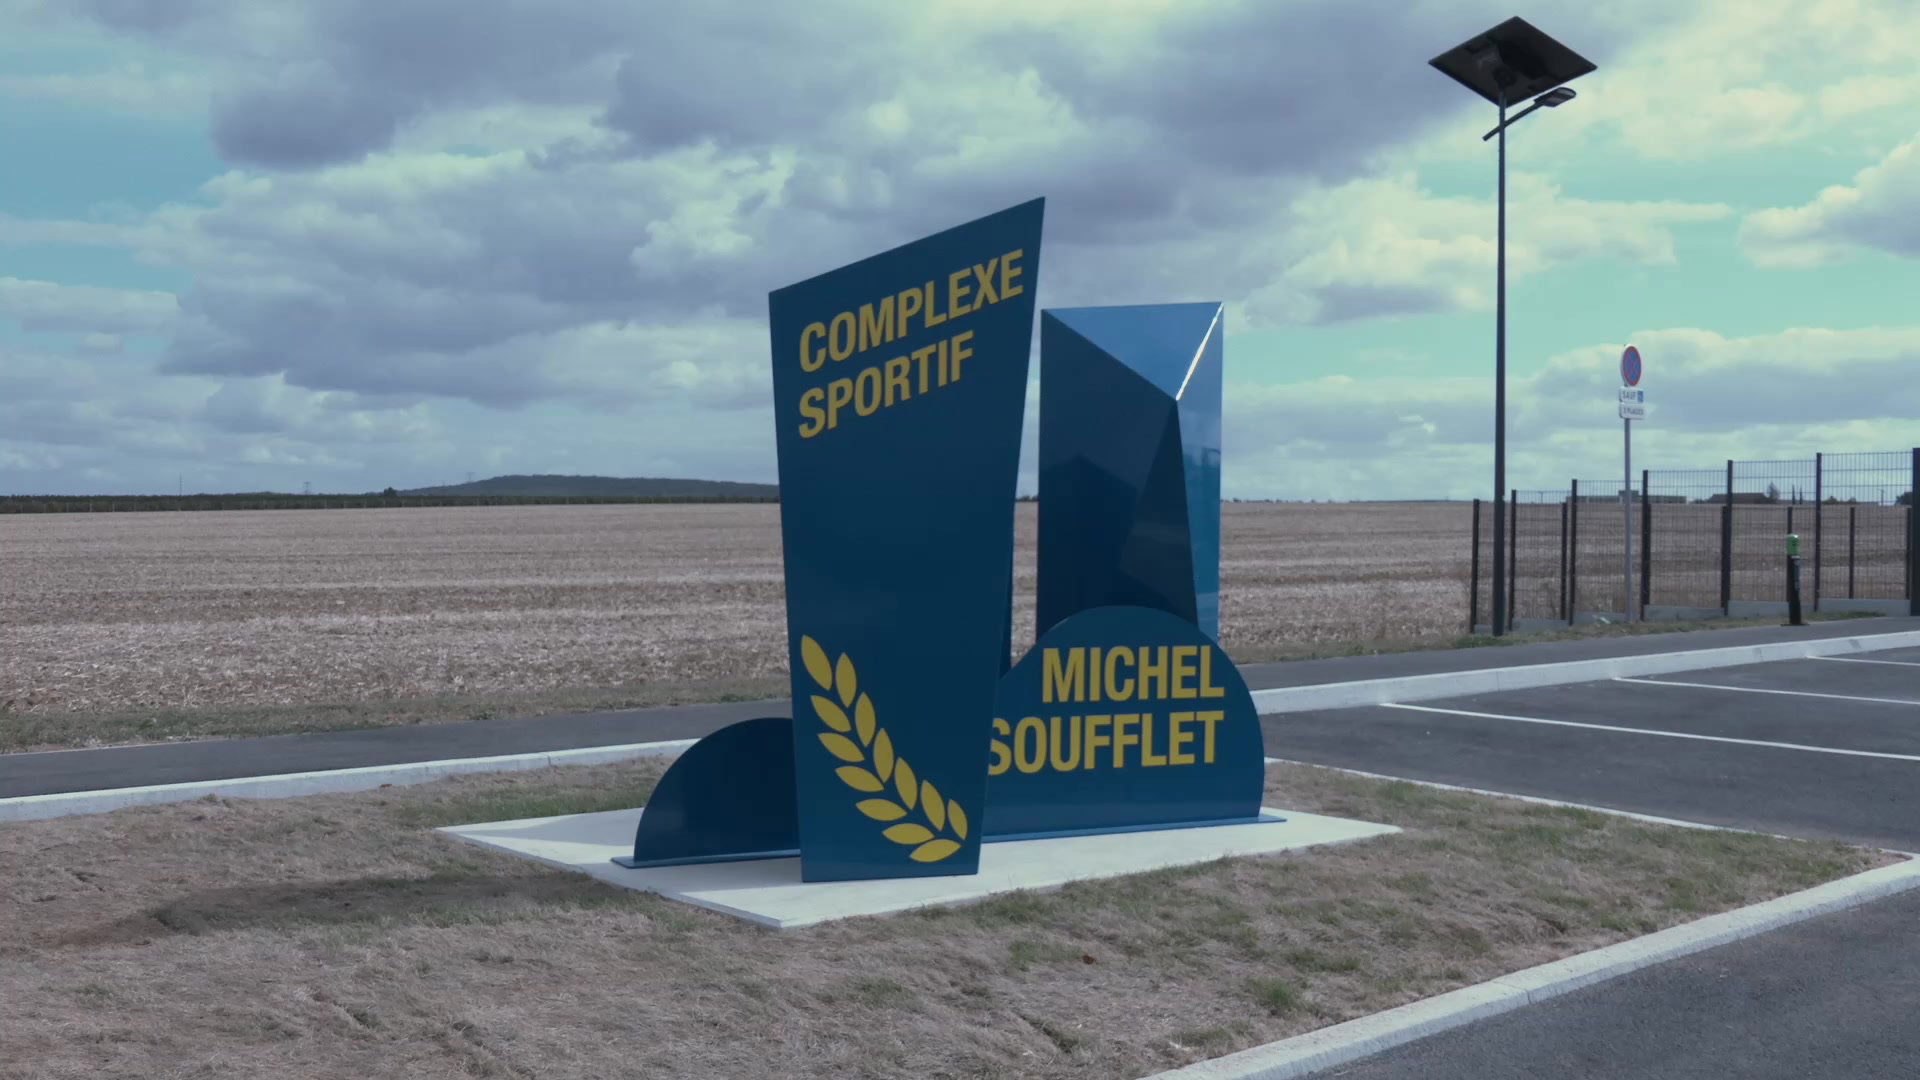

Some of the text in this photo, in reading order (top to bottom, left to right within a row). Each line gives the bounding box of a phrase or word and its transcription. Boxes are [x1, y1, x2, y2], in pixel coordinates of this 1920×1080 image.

[799, 248, 1024, 373] COMPLEXE
[798, 330, 974, 439] SPORTIF
[1042, 645, 1225, 703] MICHEL
[988, 710, 1225, 776] SOUFFLET
